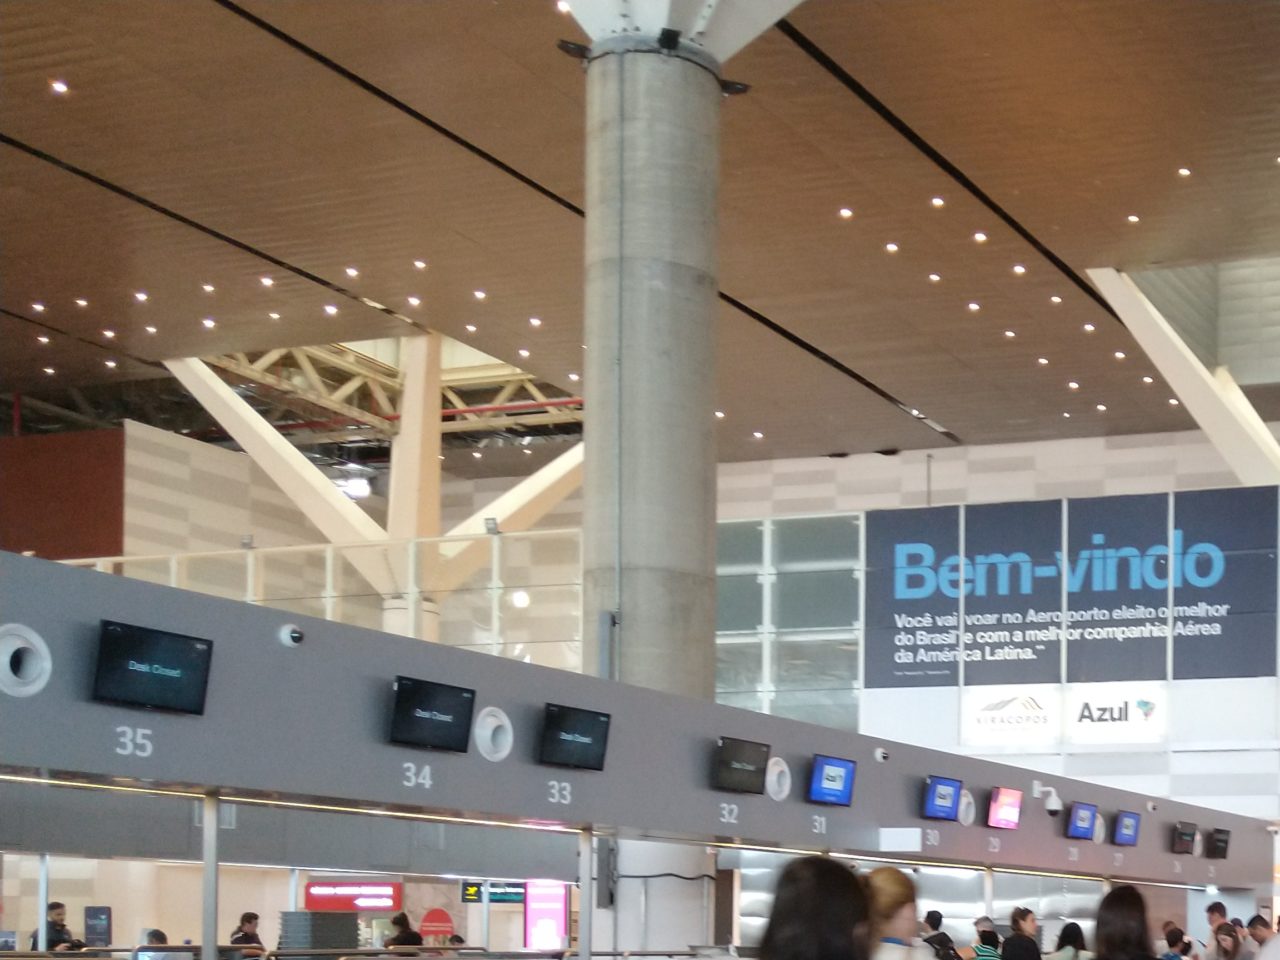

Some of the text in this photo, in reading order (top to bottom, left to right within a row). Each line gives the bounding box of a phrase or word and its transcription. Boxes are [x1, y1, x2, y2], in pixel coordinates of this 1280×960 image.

[894, 529, 1226, 599] Bem-vindo
[894, 601, 1231, 628] Você vai voar no Aeroporto eleito o melhor
[894, 631, 914, 646] do
[963, 632, 974, 644] e
[976, 630, 1010, 643] com
[1012, 630, 1023, 642] a
[1025, 626, 1082, 642] melhor
[1084, 622, 1169, 641] companhia
[1174, 620, 1222, 636] Aérea
[894, 649, 914, 663] da
[1077, 701, 1129, 722] Azul
[115, 726, 153, 757] 35
[402, 762, 433, 789] 34
[548, 780, 572, 805] 33
[719, 803, 739, 824] 32
[812, 815, 827, 834] 31
[925, 829, 941, 846] 30
